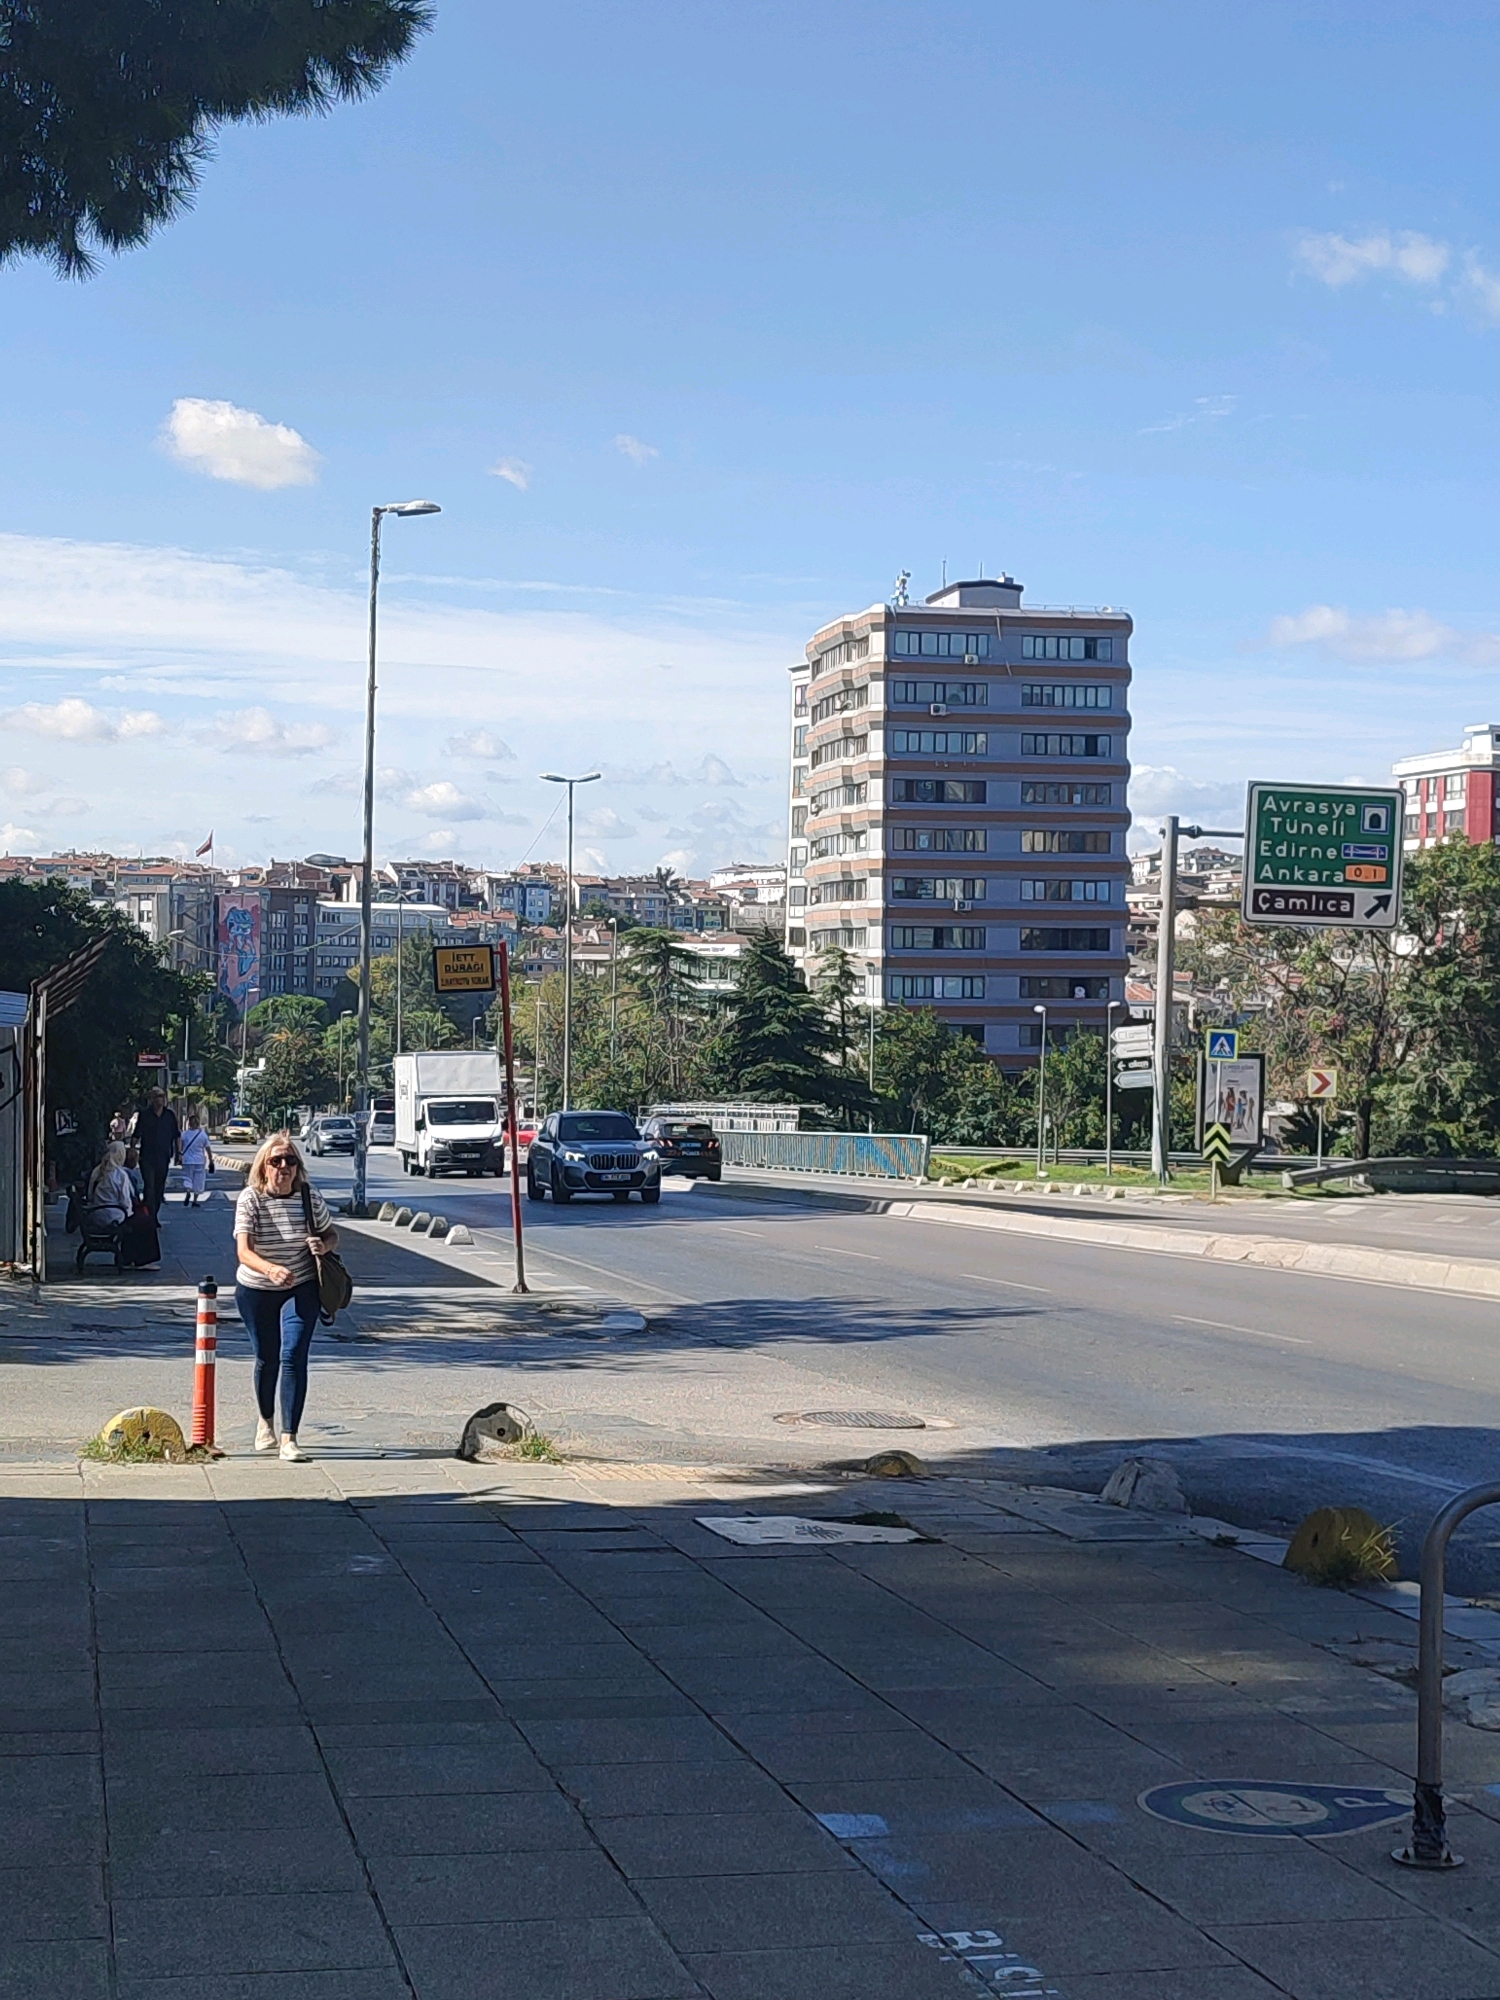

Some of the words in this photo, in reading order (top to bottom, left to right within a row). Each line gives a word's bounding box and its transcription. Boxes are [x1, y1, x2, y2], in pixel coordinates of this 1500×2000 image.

[1262, 795, 1356, 819] Avrasya
[1270, 817, 1345, 837] Tüneli
[1260, 840, 1338, 860] Edirne
[1259, 863, 1344, 883] Ankara
[1257, 892, 1351, 912] Çamlıca
